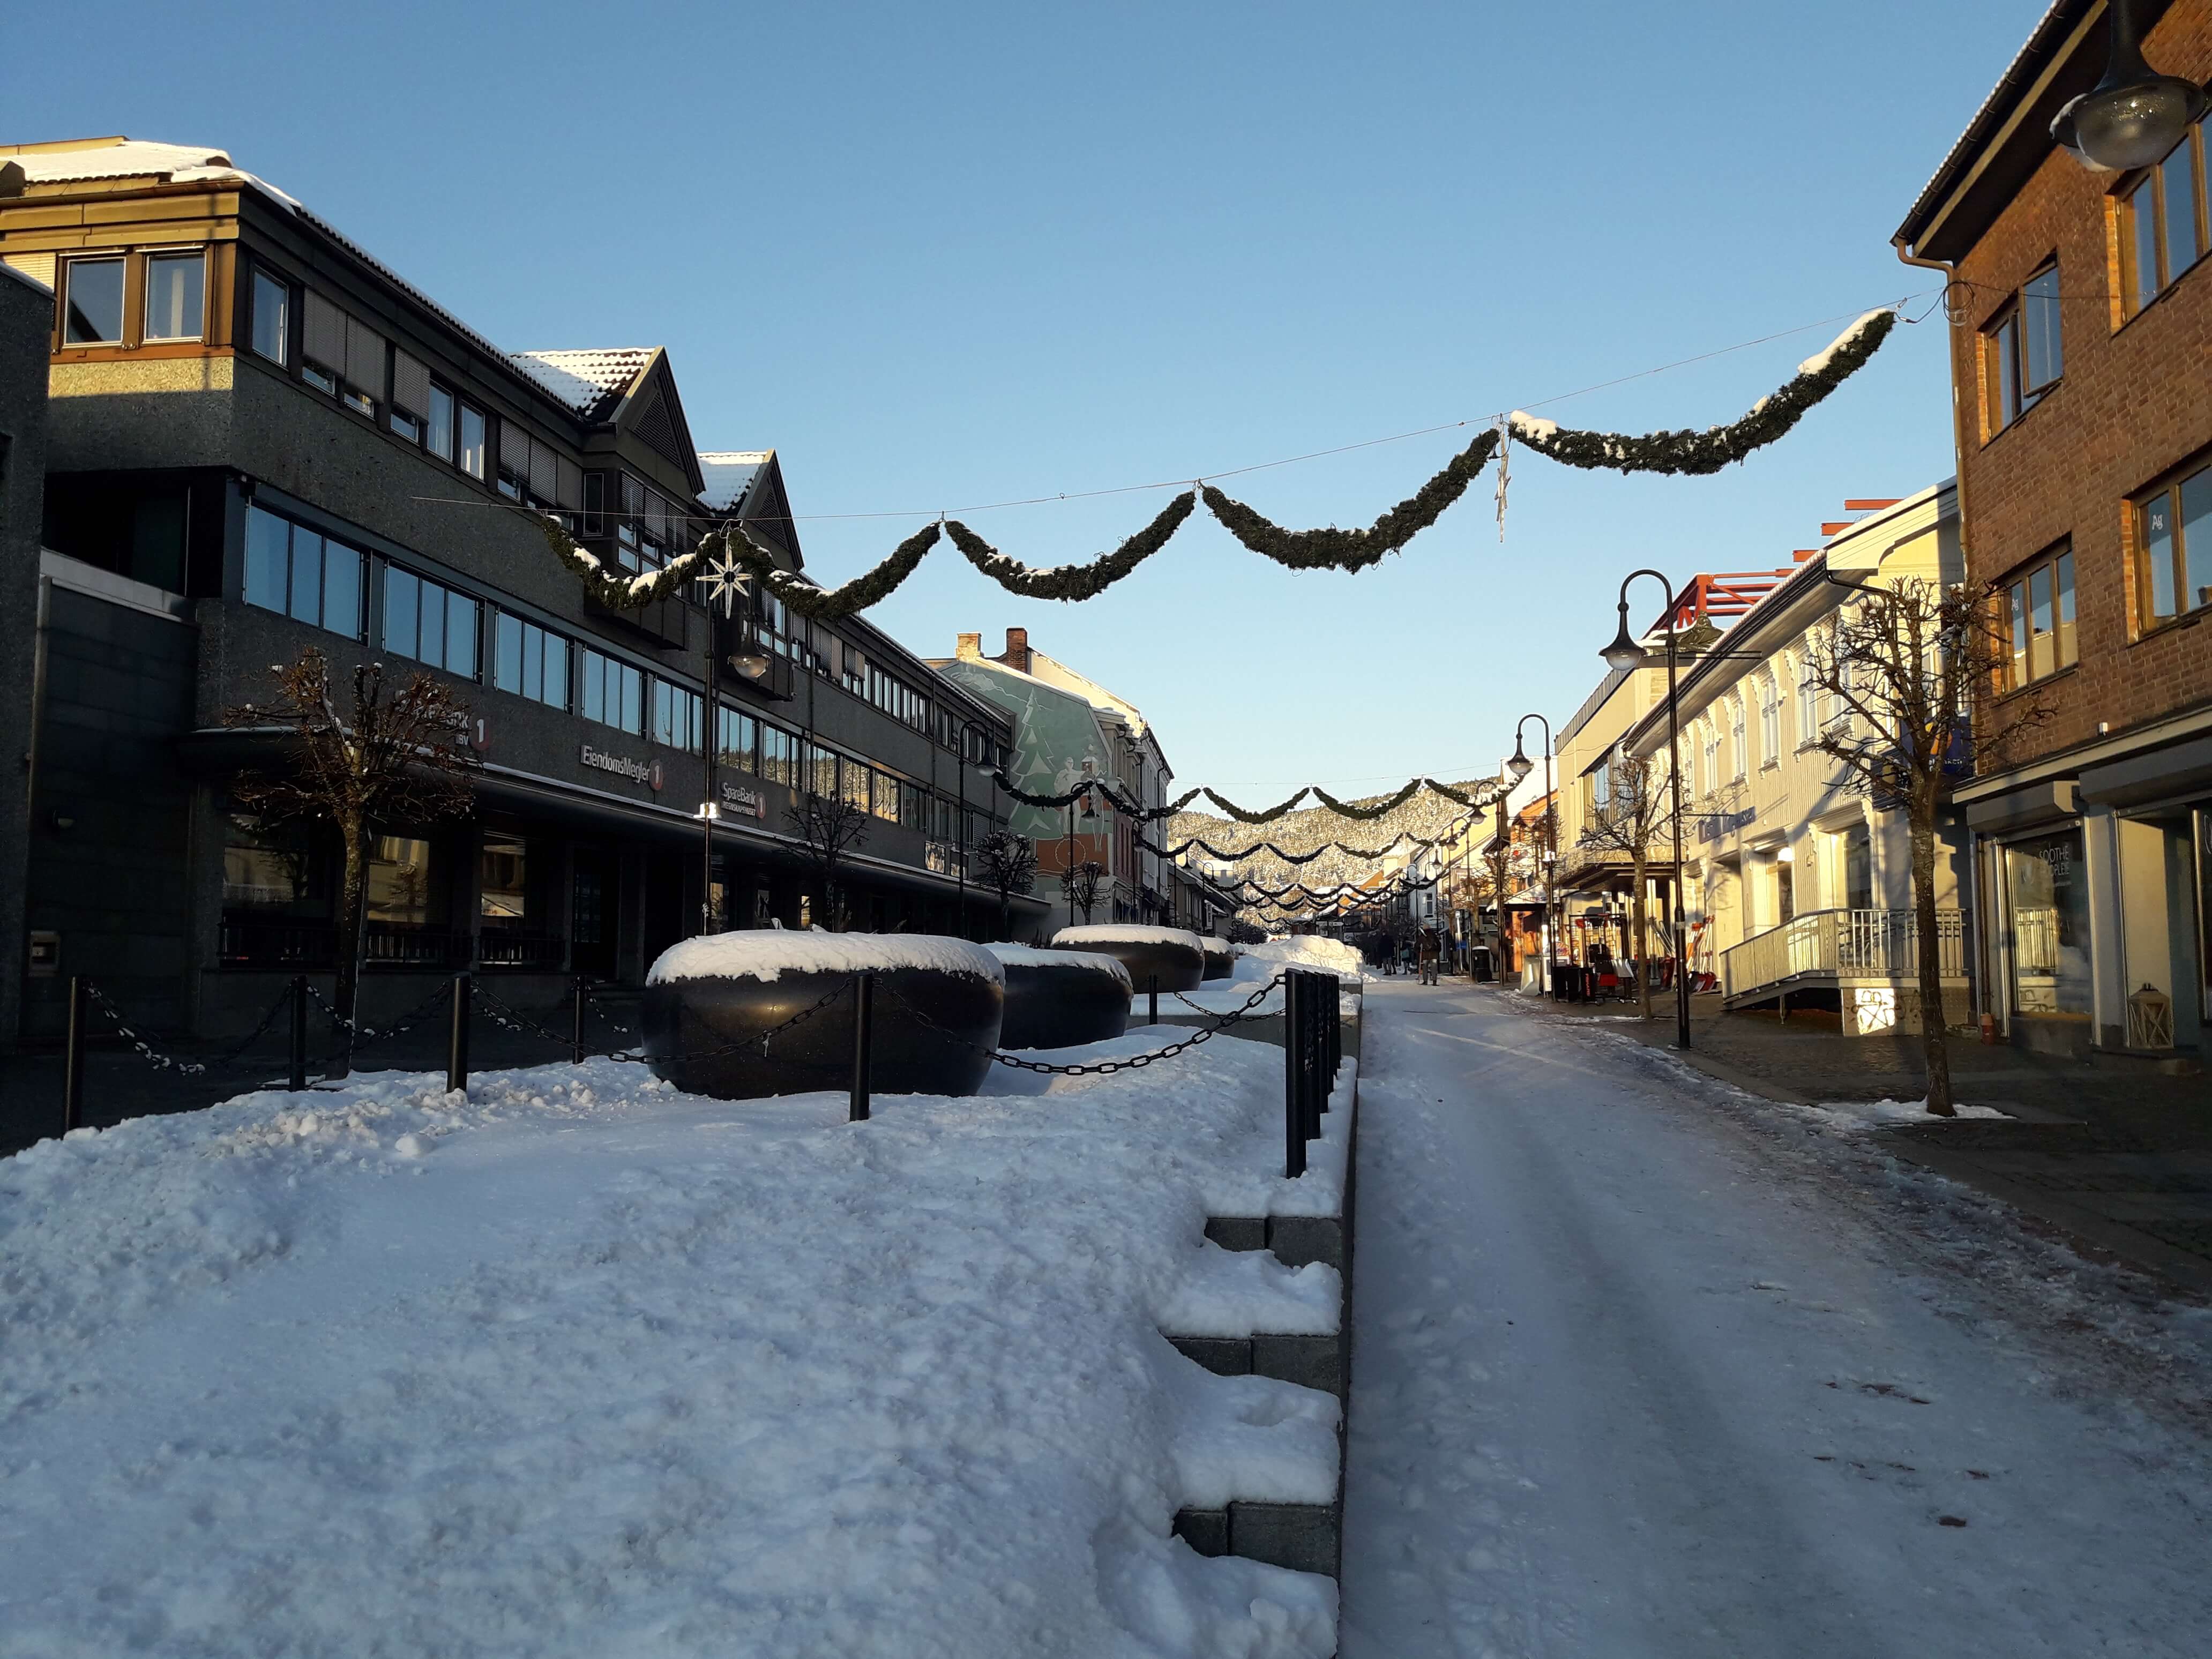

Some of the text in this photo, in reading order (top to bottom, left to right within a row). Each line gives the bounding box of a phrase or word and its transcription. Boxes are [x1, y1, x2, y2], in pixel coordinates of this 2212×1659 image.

[476, 719, 484, 743] 1
[582, 745, 650, 783] EiendomsMegler
[722, 782, 756, 805] SpareBank
